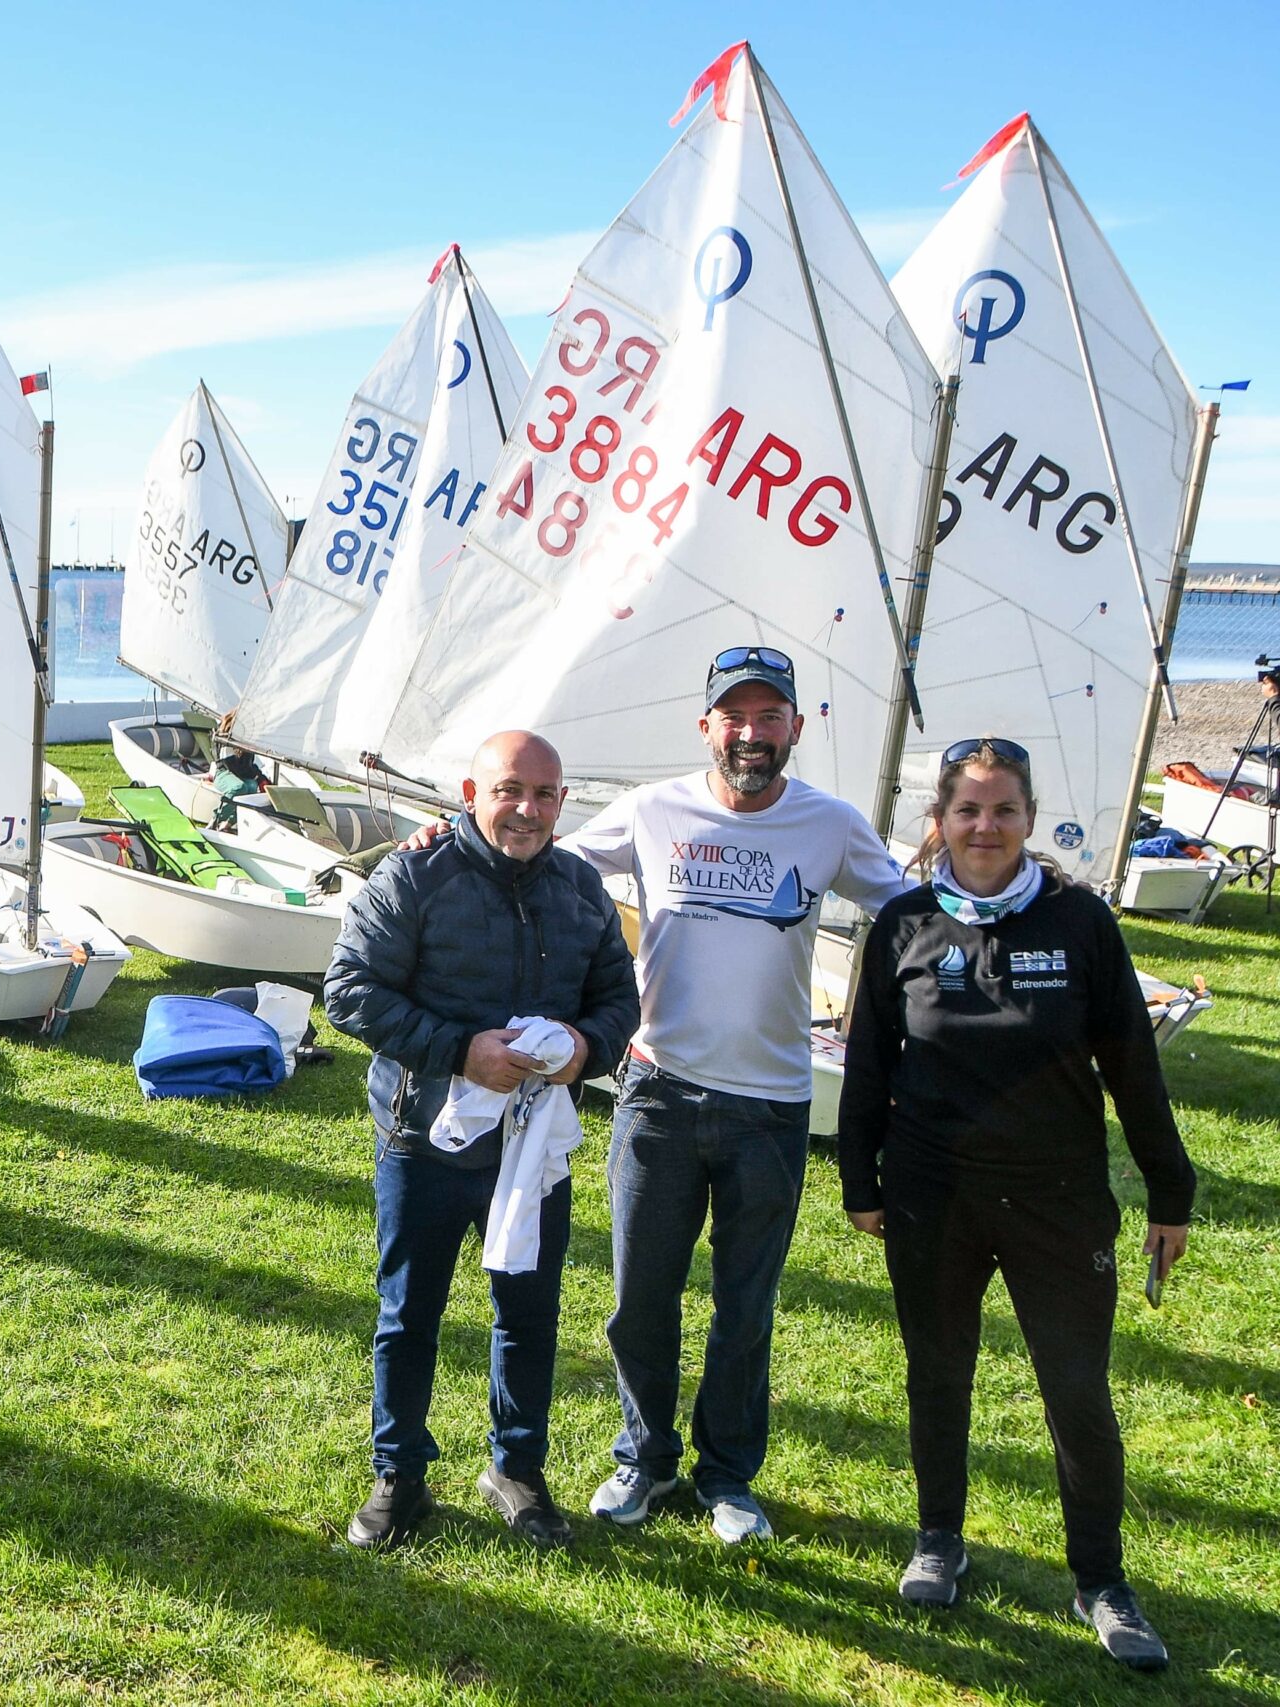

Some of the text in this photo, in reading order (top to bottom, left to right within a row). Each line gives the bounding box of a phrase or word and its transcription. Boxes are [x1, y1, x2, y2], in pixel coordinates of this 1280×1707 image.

[526, 385, 690, 548] 3884
[685, 406, 852, 548] ARG
[956, 432, 1117, 554] ARG
[139, 510, 199, 580] 3557
[190, 528, 258, 585] ARG
[669, 865, 775, 893] BALLENAS
[739, 866, 775, 878] DE LAS
[669, 911, 719, 922] Puerto Madryn
[1012, 978, 1068, 990] Entrenador
